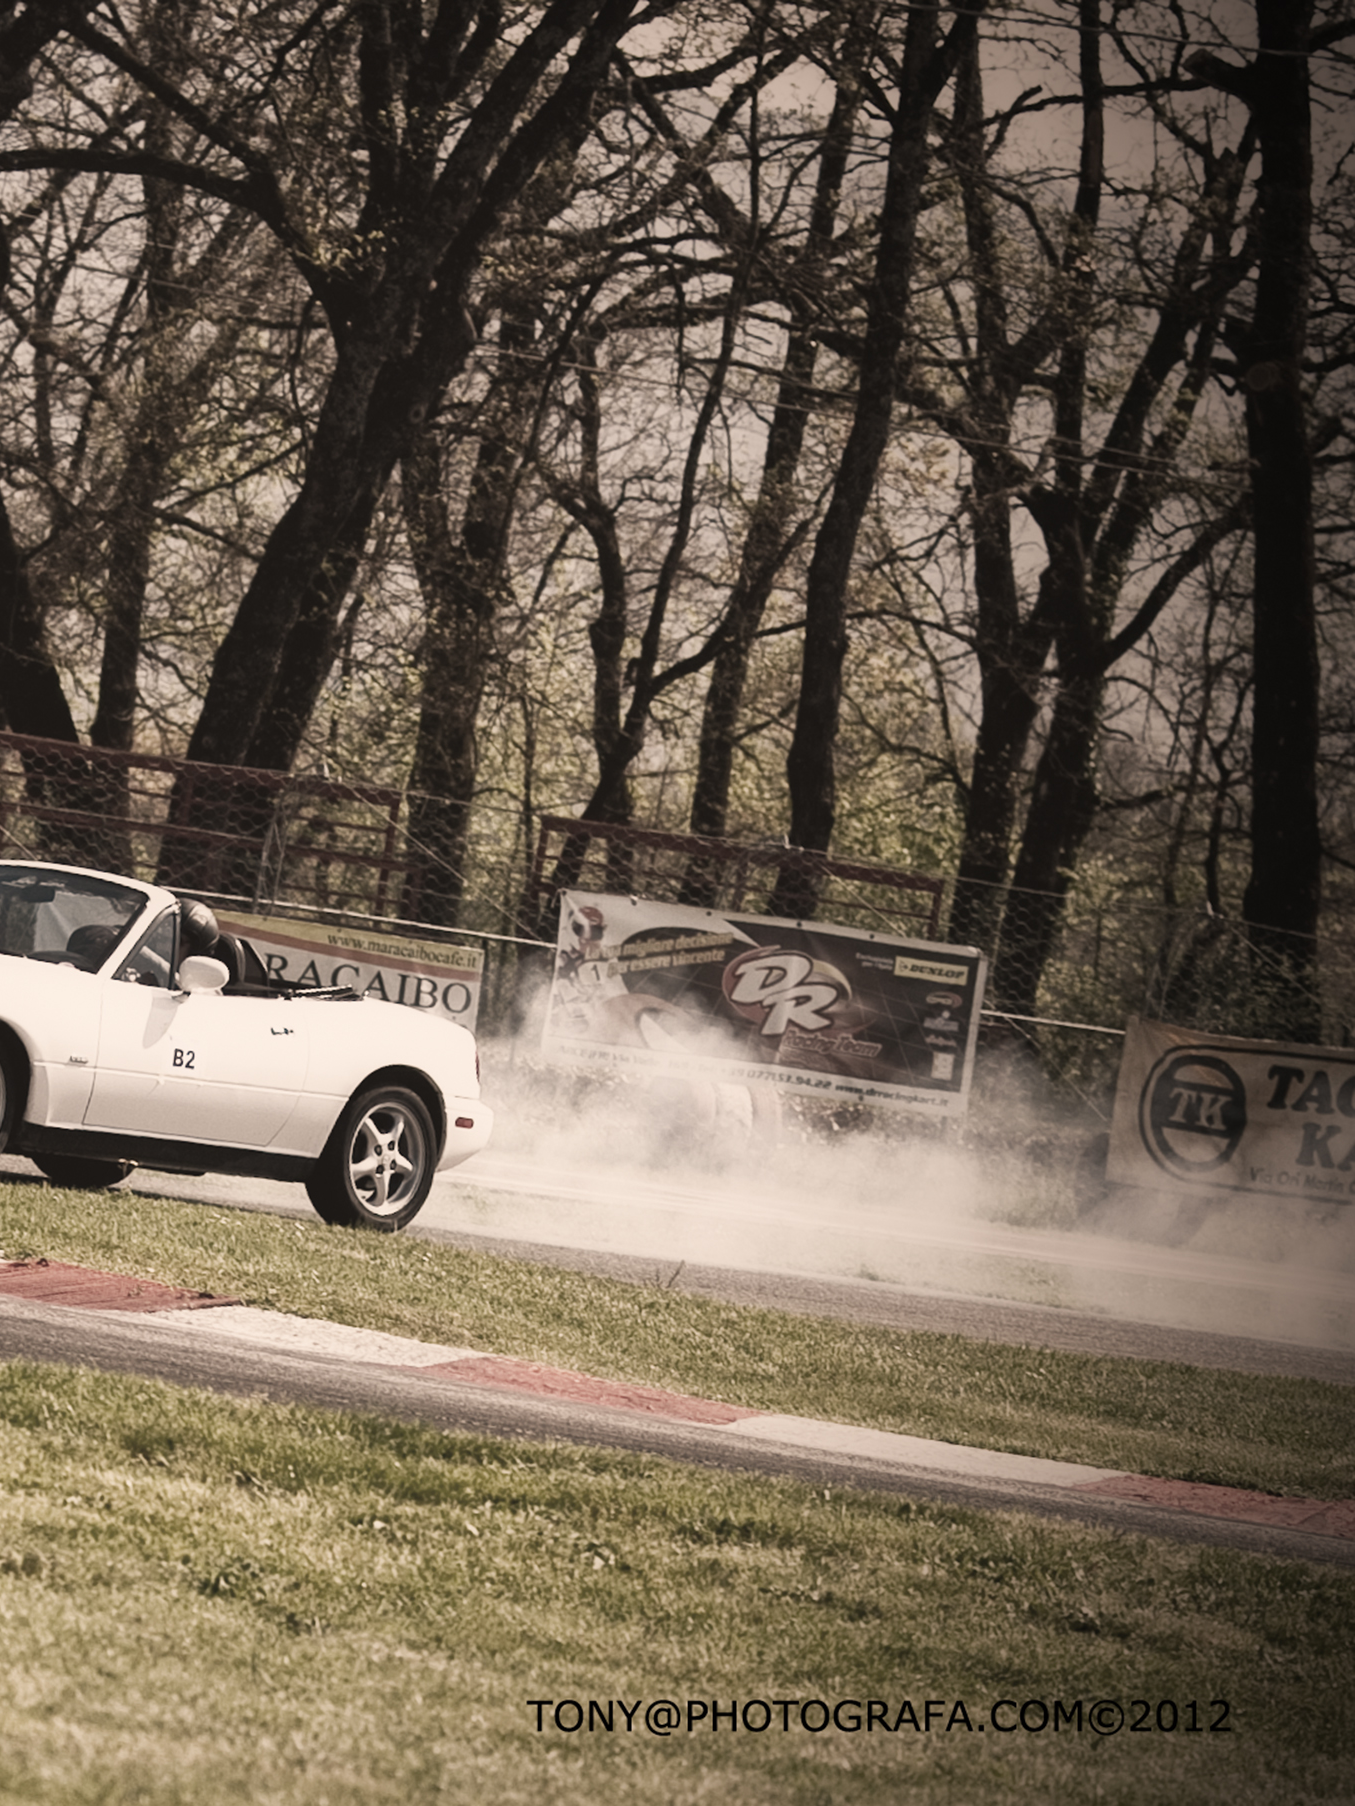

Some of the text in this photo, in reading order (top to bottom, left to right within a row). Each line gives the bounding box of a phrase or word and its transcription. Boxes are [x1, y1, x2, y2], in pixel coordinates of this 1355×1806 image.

[327, 934, 477, 969] www.maracaibocafe.it
[908, 963, 965, 979] DUNLOP
[730, 952, 834, 1036] DR
[172, 1047, 196, 1070] B2
[1168, 1086, 1233, 1131] TK
